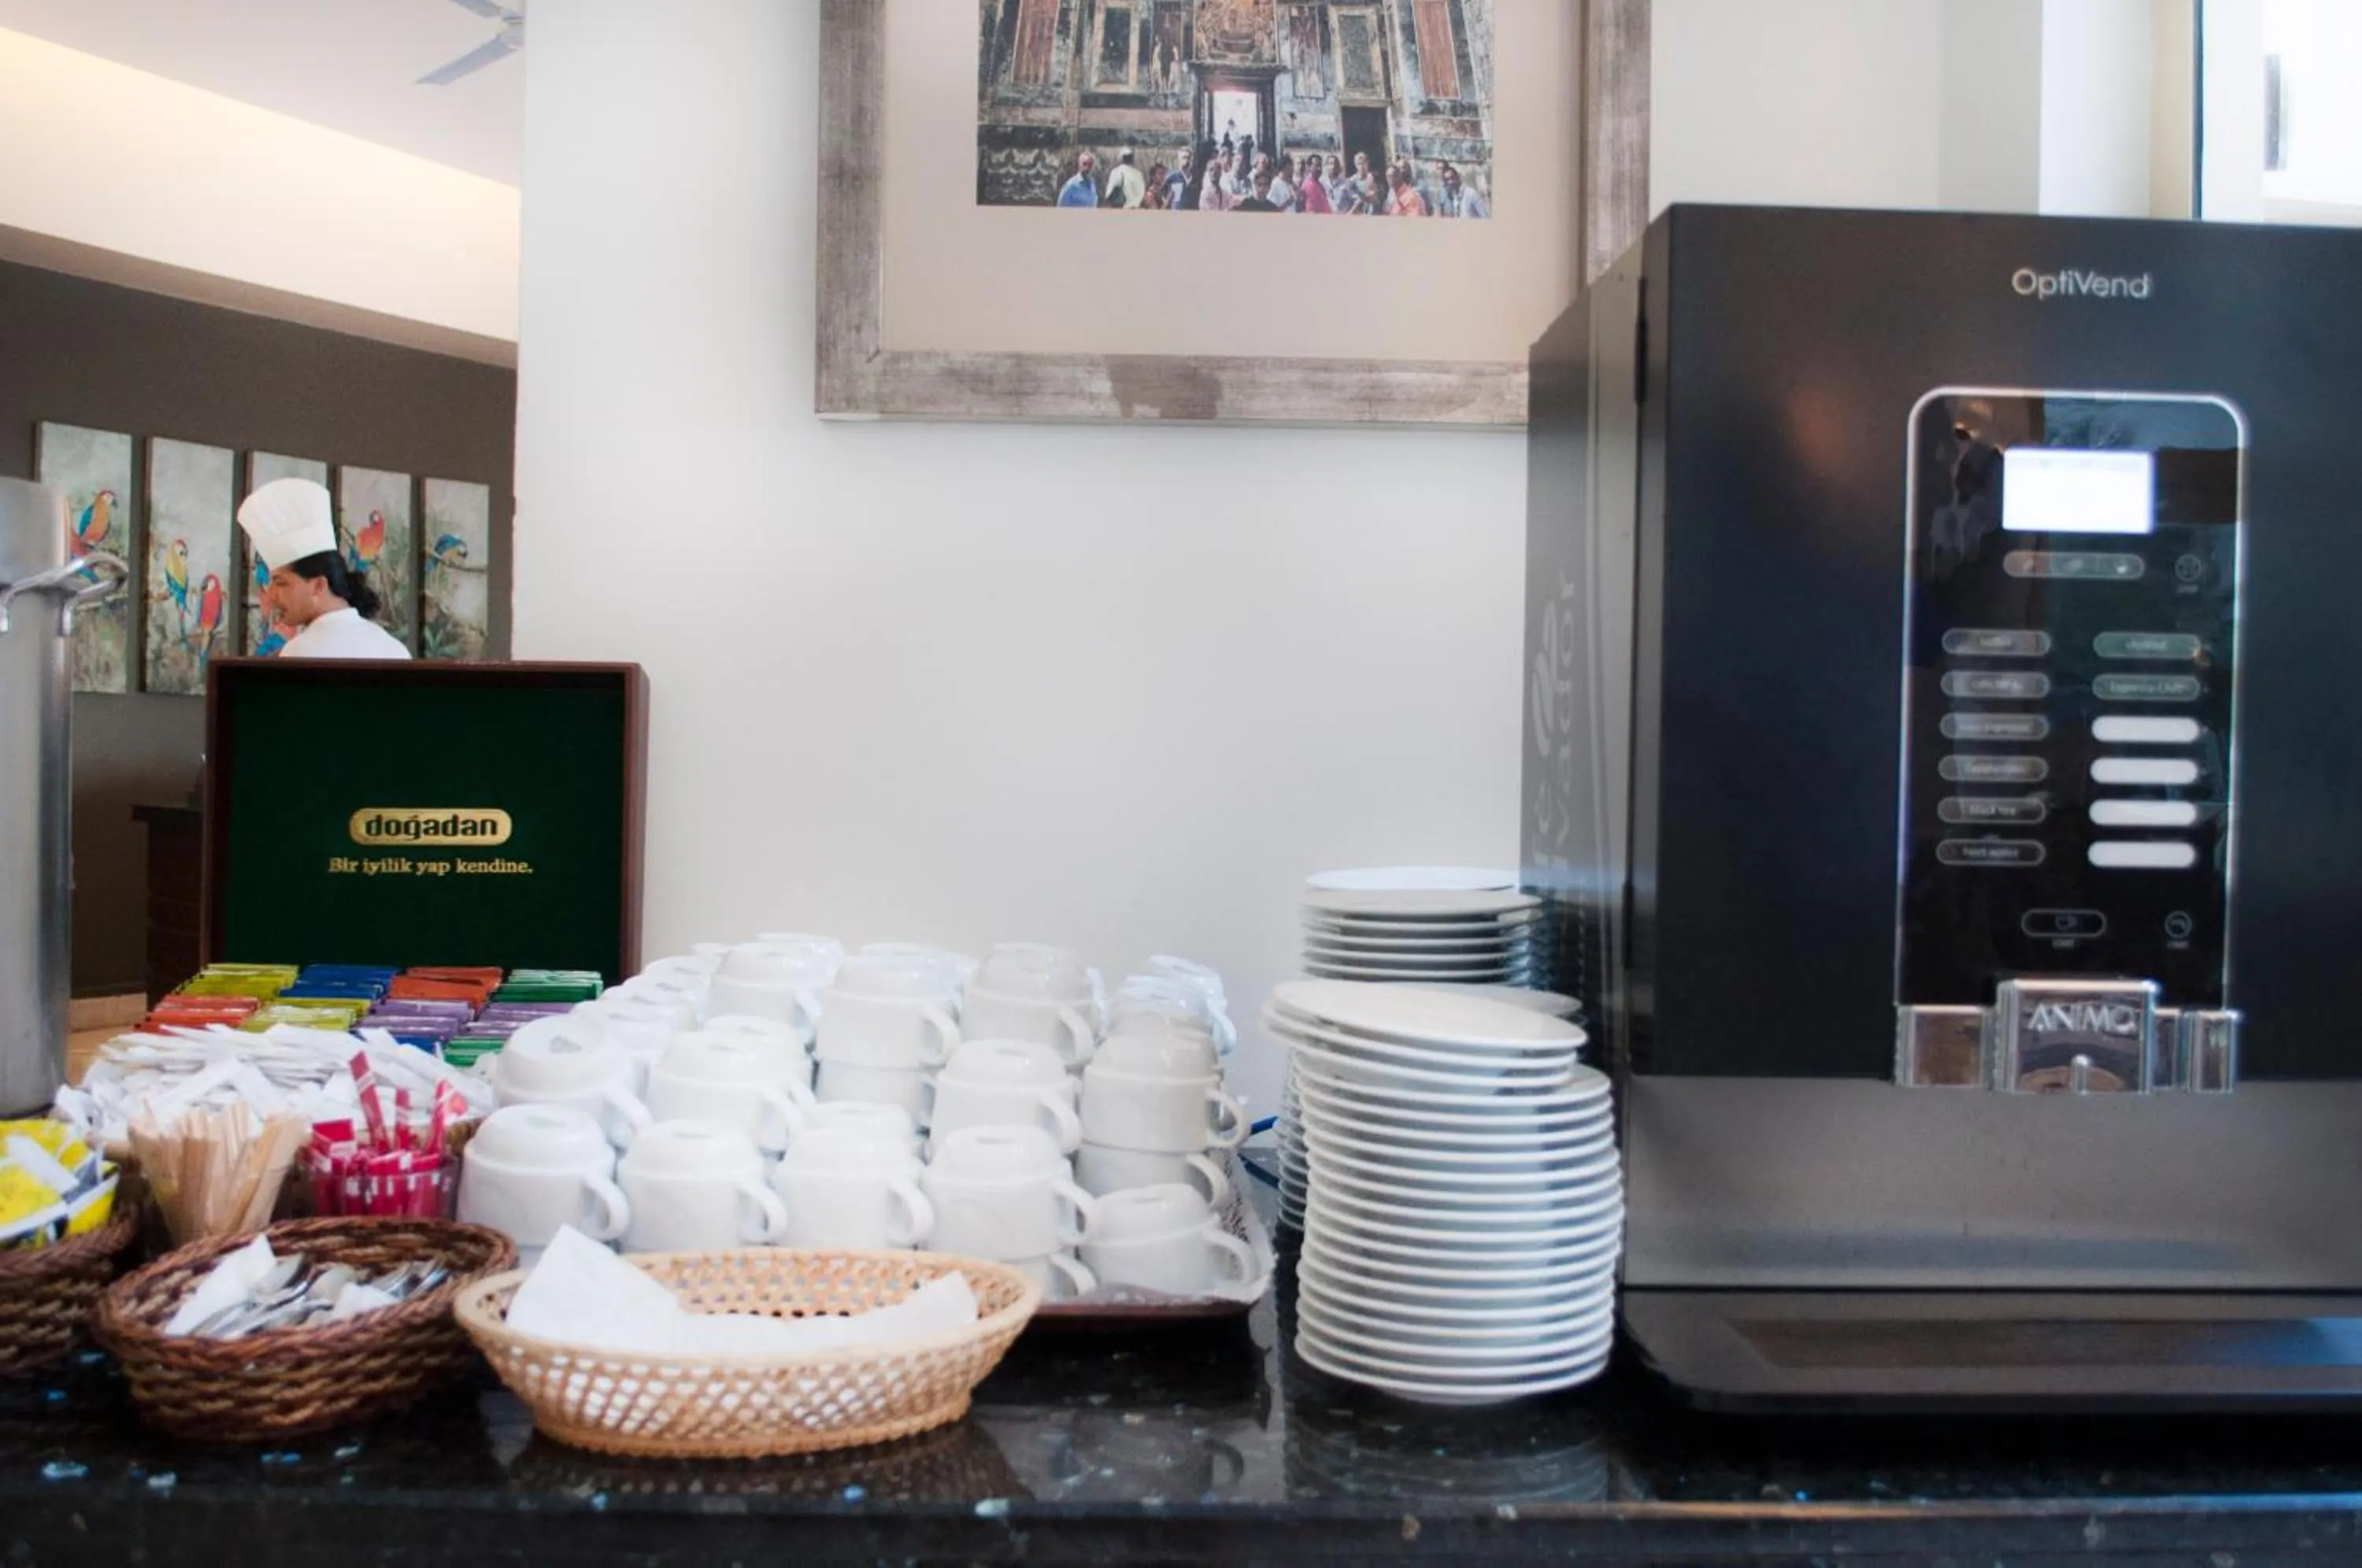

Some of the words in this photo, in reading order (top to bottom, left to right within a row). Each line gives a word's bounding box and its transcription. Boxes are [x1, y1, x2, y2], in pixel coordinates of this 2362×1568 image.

[2011, 268, 2150, 301] OptiVend
[328, 856, 359, 874] Bir
[362, 856, 413, 876] iyilik
[416, 860, 451, 876] yap
[455, 856, 534, 874] kendine.
[2027, 1002, 2138, 1034] ANIMO
